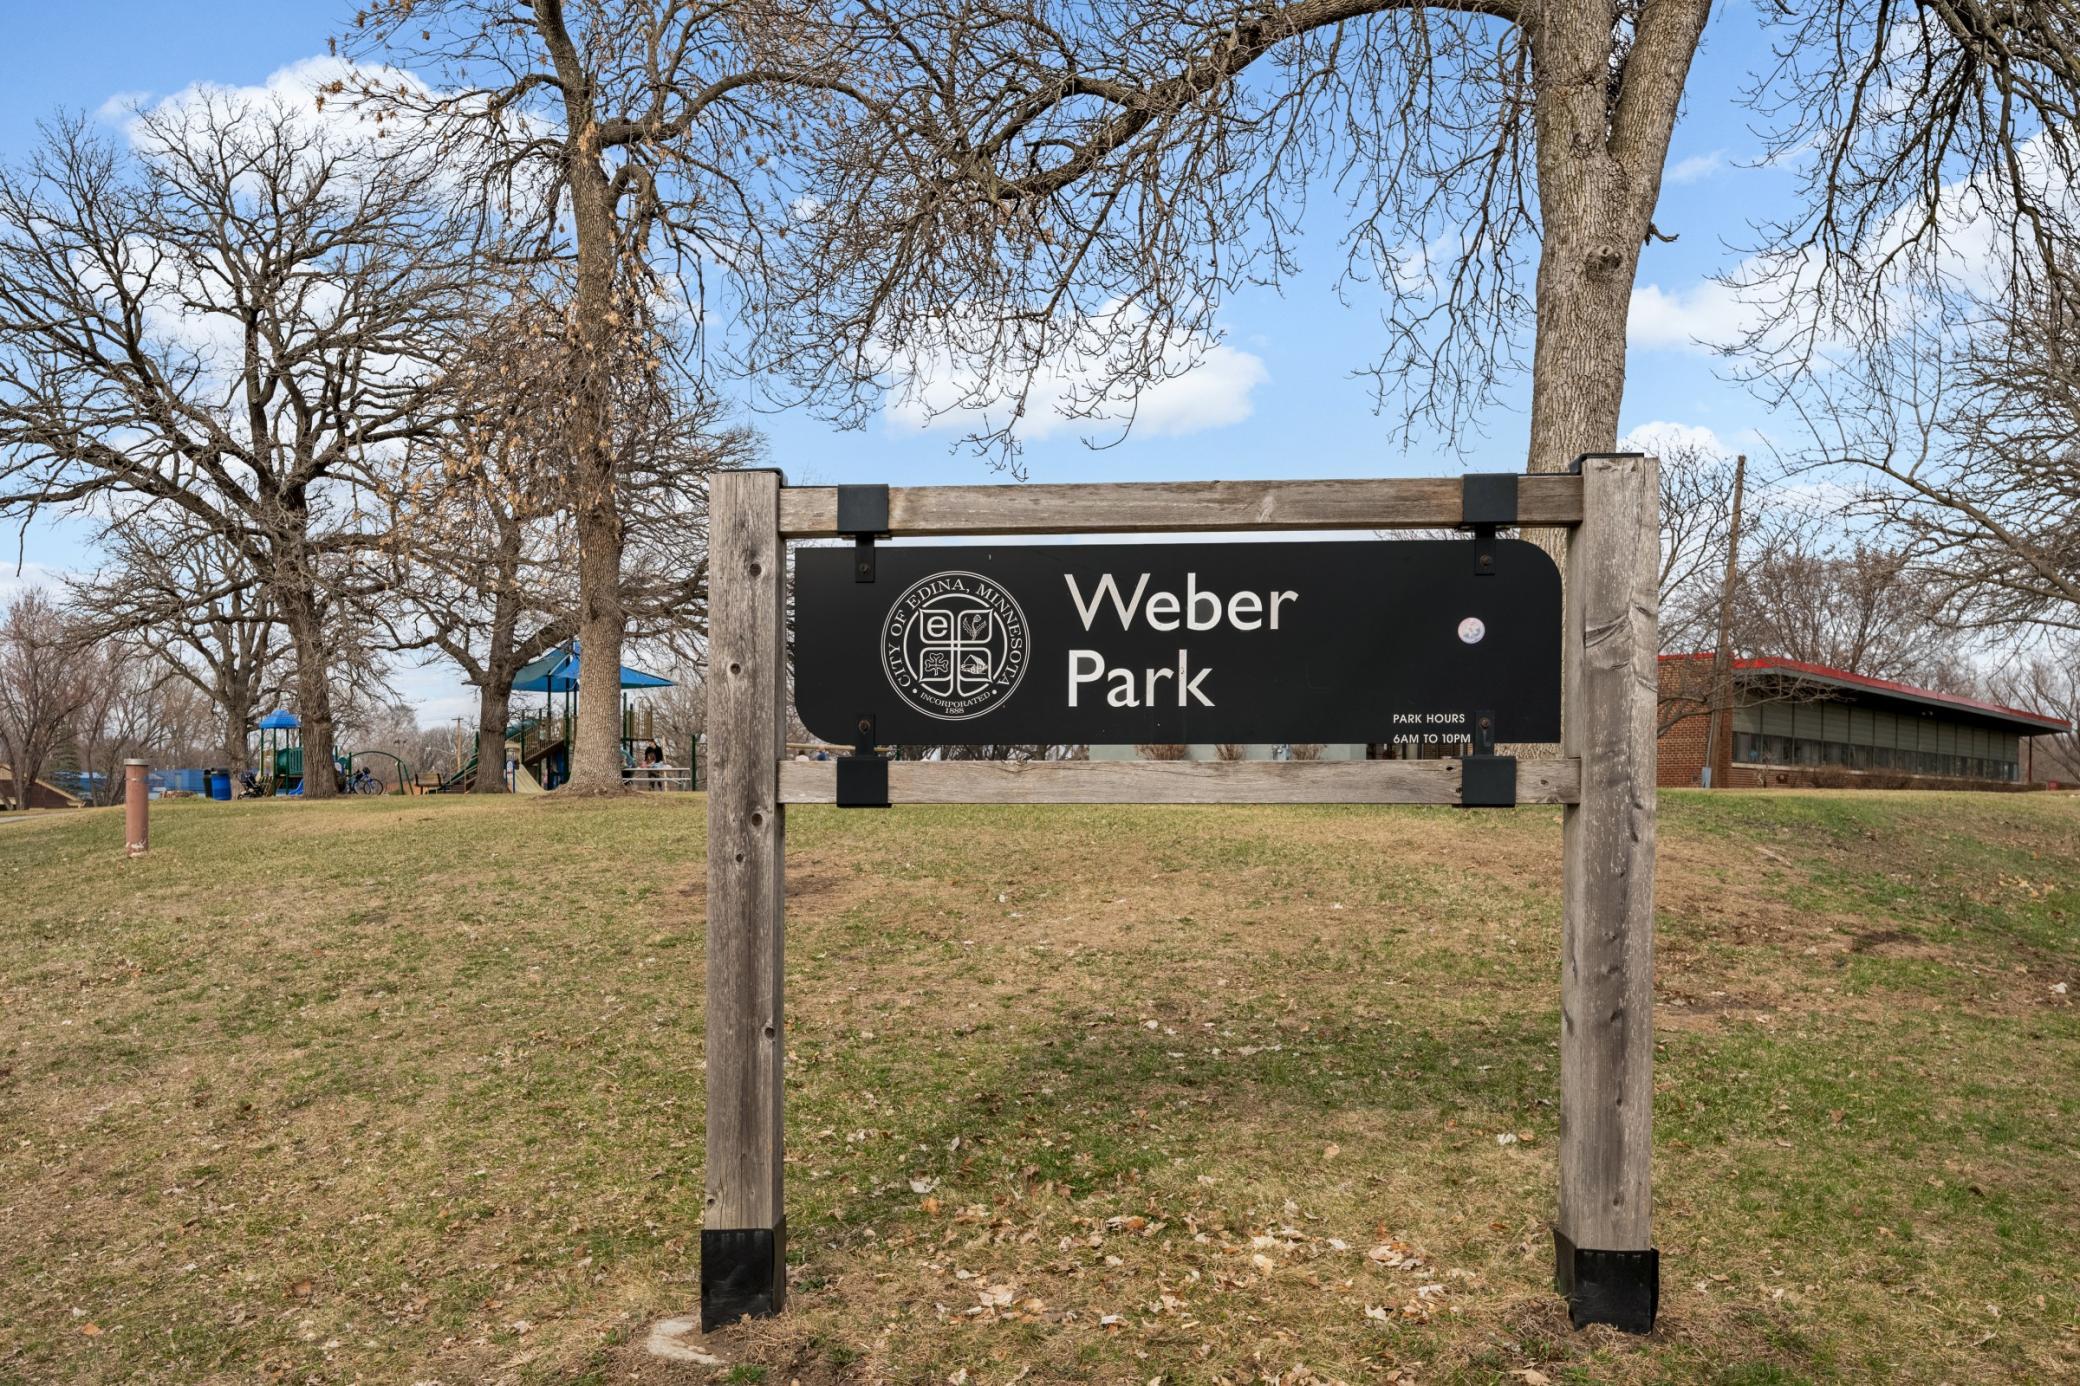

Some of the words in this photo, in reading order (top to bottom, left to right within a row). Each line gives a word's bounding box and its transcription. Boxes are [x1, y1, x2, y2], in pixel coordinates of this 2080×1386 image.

[1064, 572, 1299, 632] Weber
[890, 609, 907, 637] OF
[975, 583, 1023, 686] MINNESOTA
[888, 642, 911, 687] CITY
[1068, 649, 1216, 708] Park
[920, 690, 991, 708] INCORPORATED
[1393, 713, 1422, 724] PARK
[1426, 713, 1465, 724] HOURS
[1393, 733, 1419, 744] 6AM
[1423, 733, 1438, 744] TO
[1442, 733, 1471, 744] 10PM
